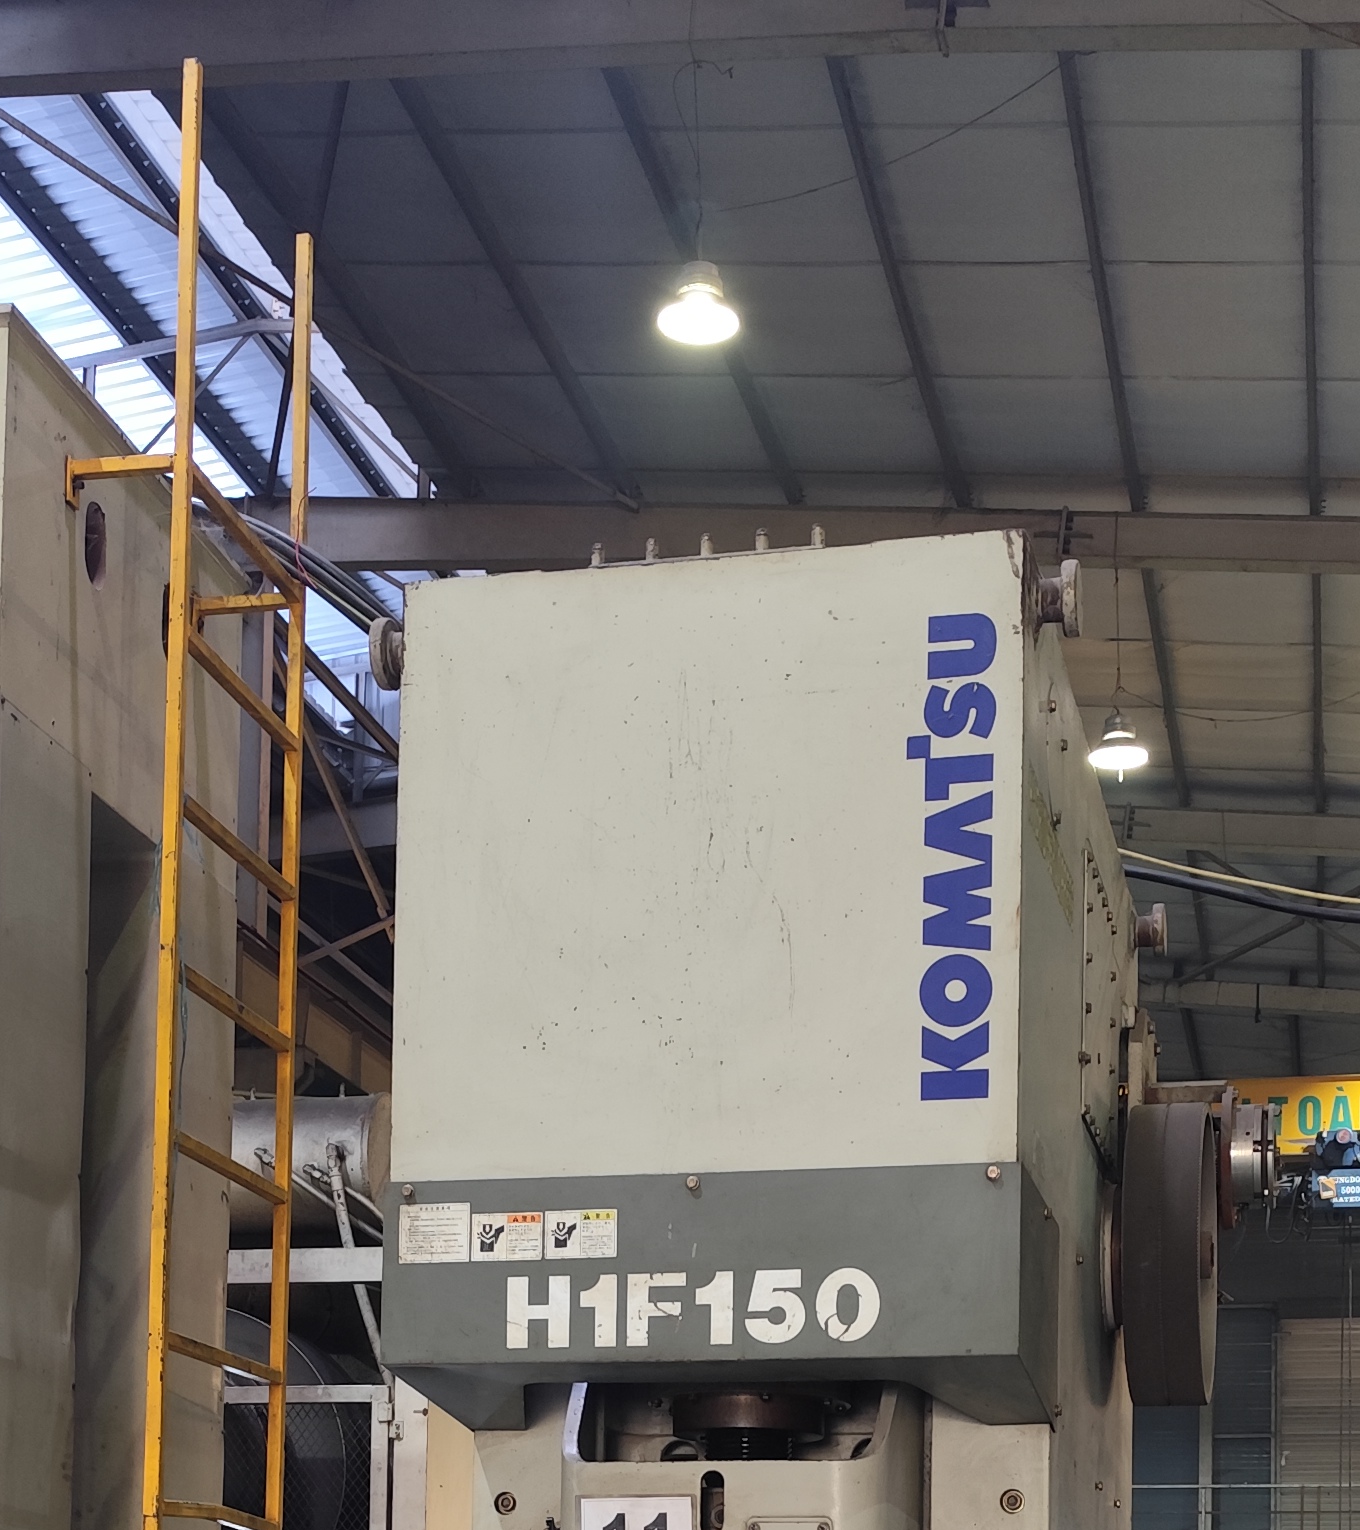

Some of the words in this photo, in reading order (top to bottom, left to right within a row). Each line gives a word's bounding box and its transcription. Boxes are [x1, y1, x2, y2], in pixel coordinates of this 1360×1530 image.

[907, 613, 997, 1101] KOMATSU
[1340, 1185, 1360, 1195] 5000
[506, 1267, 881, 1350] H1F150
